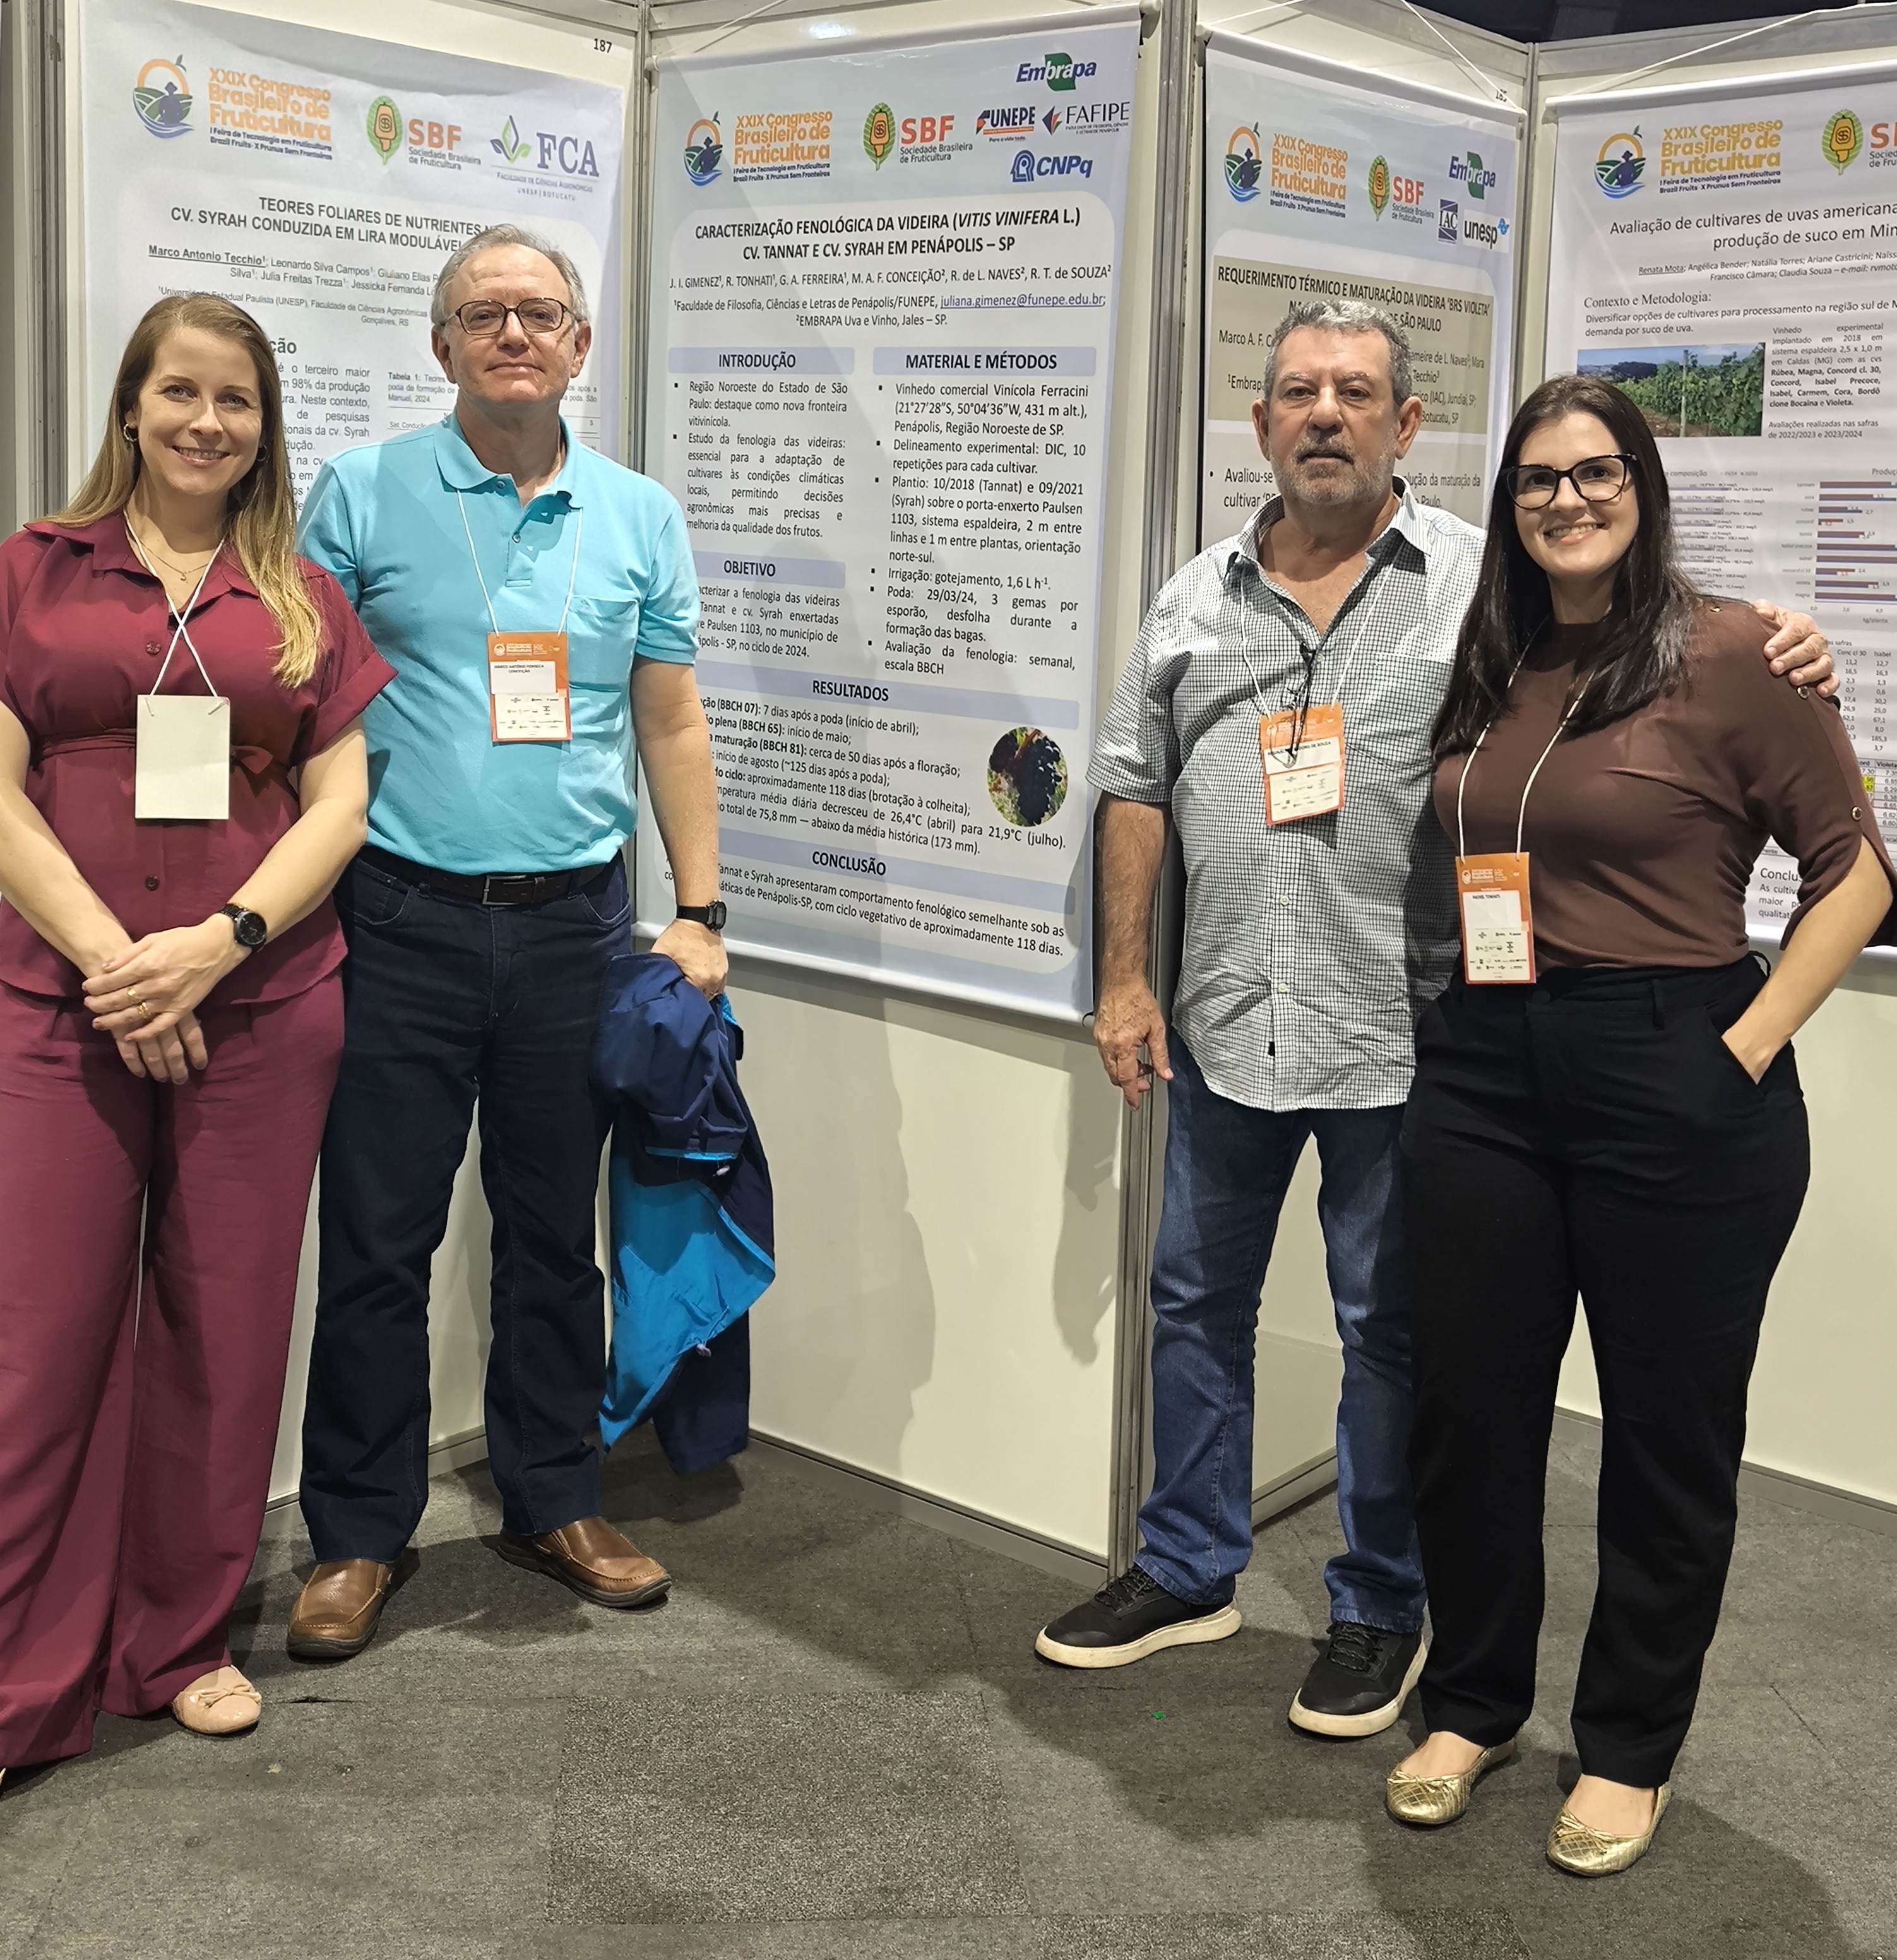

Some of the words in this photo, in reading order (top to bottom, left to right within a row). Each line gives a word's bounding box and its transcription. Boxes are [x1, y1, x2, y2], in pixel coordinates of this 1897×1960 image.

[593, 38, 612, 53] 187
[1016, 61, 1097, 85] Embrapa
[209, 68, 246, 87] XXIX
[249, 74, 331, 102] Congresso
[209, 83, 302, 115] Brasileiro
[305, 101, 329, 120] de
[210, 104, 331, 141] Fruticultura
[736, 115, 766, 128] XXIX
[766, 110, 833, 126] Congresso
[1066, 102, 1130, 124] FAFIPE
[408, 118, 462, 151] SBF
[735, 123, 807, 145] Brasileiro
[809, 122, 831, 141] de
[901, 115, 955, 145] SBF
[537, 132, 600, 177] FCA
[734, 143, 831, 165] Fruticultura
[900, 145, 937, 155] Sociedade
[939, 142, 973, 153] Brasileira
[900, 155, 909, 163] de
[911, 153, 951, 163] Fruticultura
[1036, 155, 1093, 178] CNPq
[1449, 155, 1496, 188] Embrapa
[1393, 175, 1425, 206] SBF
[171, 207, 193, 222] CV.
[198, 210, 246, 228] SYRAH
[252, 217, 332, 237] CONDUZIDA
[336, 226, 354, 240] EM
[359, 229, 386, 244] LIRA
[259, 197, 314, 216] TEORES
[319, 205, 381, 224] FOLIARES
[386, 213, 401, 227] DE
[406, 215, 481, 236] NUTRIENTES
[696, 219, 793, 239] CARACTERIZAÇÃO
[797, 216, 873, 234] FENOLÓGICA
[877, 217, 894, 231] DA
[898, 215, 949, 230] VIDEIRA
[953, 212, 991, 231] (VITIS
[996, 210, 1059, 226] VINIFERA
[1064, 207, 1079, 227] L.)
[1439, 210, 1458, 229] IAC
[1610, 218, 1671, 234] Avaliação
[1675, 217, 1692, 230] de
[1696, 213, 1761, 228] cultivares
[1766, 210, 1783, 223] de
[1788, 210, 1819, 222] uvas
[1464, 220, 1497, 249] unesp
[1714, 232, 1779, 251] produção
[1783, 230, 1800, 244] de
[1805, 230, 1838, 242] suco
[1842, 229, 1865, 240] em
[744, 246, 759, 259] CV.
[763, 244, 809, 259] TANNAT
[813, 244, 819, 257] E
[823, 243, 840, 257] CV.
[845, 242, 884, 256] SYRAH
[888, 241, 907, 254] EM
[912, 235, 983, 254] PENÁPOLIS
[999, 237, 1015, 251] SP
[149, 244, 180, 257] Marco
[182, 248, 221, 261] Antonio
[271, 258, 311, 270] Leonardo
[313, 261, 333, 272] Silva
[378, 268, 410, 280] Giuliano
[412, 271, 431, 282] Elias
[1218, 266, 1297, 290] REQUERIMENTO
[1299, 277, 1340, 295] TÉRMICO
[1342, 283, 1347, 297] E
[1349, 284, 1402, 305] MATURAÇÃO
[1404, 292, 1414, 306] DA
[1416, 294, 1446, 309] VIDEIRA
[715, 300, 725, 310] de
[727, 299, 764, 311] Filosofia,
[766, 299, 800, 309] Ciências
[810, 299, 836, 309] Letras
[838, 297, 849, 308] de
[852, 295, 937, 310] Penápolis/FUNEPE,
[941, 293, 1106, 309] juliana.gimenez@funepe.edu.br;
[1584, 297, 1630, 308] Contexto
[1642, 291, 1711, 305] Metodologia:
[1400, 312, 1415, 328] SÃO
[1417, 316, 1441, 331] PAULO
[1218, 330, 1246, 345] Marco
[1247, 332, 1256, 346] A.
[1258, 333, 1264, 346] F.
[305, 364, 338, 376] terceiro
[345, 367, 370, 377] maior
[719, 351, 795, 371] INTRODUÇÃO
[907, 355, 970, 369] MATERIAL
[975, 355, 982, 369] E
[986, 351, 1057, 369] MÉTODOS
[292, 377, 312, 389] 98%
[315, 380, 326, 389] da
[329, 381, 370, 393] produção
[690, 381, 714, 394] Região
[719, 381, 756, 392] Noroeste
[762, 381, 773, 393] do
[780, 382, 809, 393] Estado
[815, 382, 826, 393] de
[831, 383, 848, 394] São
[896, 383, 935, 395] Vinhedo
[940, 384, 988, 395] comercial
[994, 384, 1035, 396] Vinícola
[1042, 385, 1088, 396] Ferracini
[1227, 373, 1264, 393] ¹Embrap
[1025, 404, 1044, 415] 431
[1049, 407, 1059, 416] m
[724, 561, 775, 577] OBJETIVO
[813, 680, 888, 701] RESULTADOS
[812, 852, 886, 876] CONCLUSÃO
[746, 886, 755, 897] de
[758, 888, 812, 910] Penápolis-SP,
[815, 901, 834, 912] com
[836, 904, 857, 917] ciclo
[859, 910, 907, 926] vegetativo
[910, 917, 921, 929] de
[924, 922, 1014, 947] aproximadamente
[1017, 937, 1036, 951] 118
[1039, 941, 1062, 956] dias.
